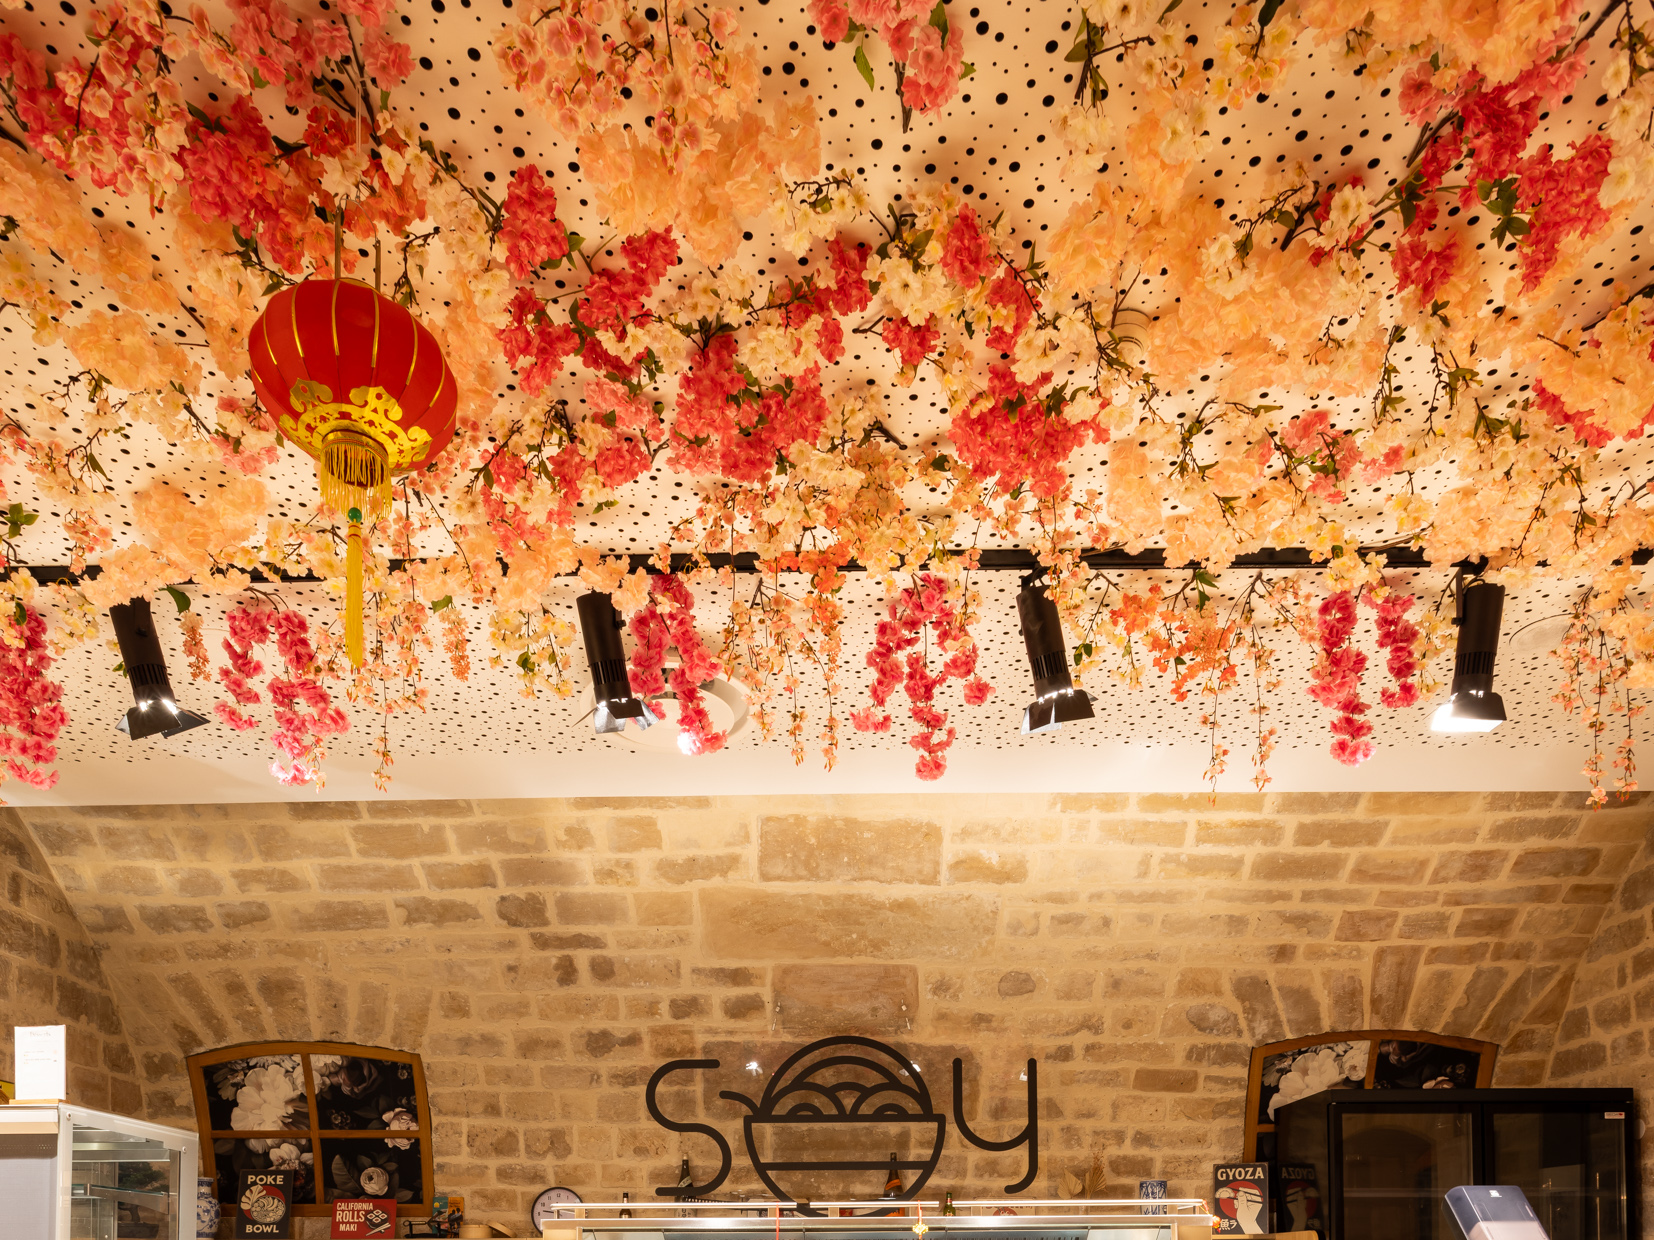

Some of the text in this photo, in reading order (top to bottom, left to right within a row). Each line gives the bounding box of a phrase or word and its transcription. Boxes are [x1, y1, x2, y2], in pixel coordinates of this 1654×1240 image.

[1217, 1167, 1265, 1181] GYOZA
[247, 1175, 284, 1185] POKE
[336, 1202, 374, 1211] CALIFORNIA
[335, 1210, 366, 1222] ROLLS
[245, 1224, 280, 1233] BOWL
[339, 1223, 358, 1232] MAKI
